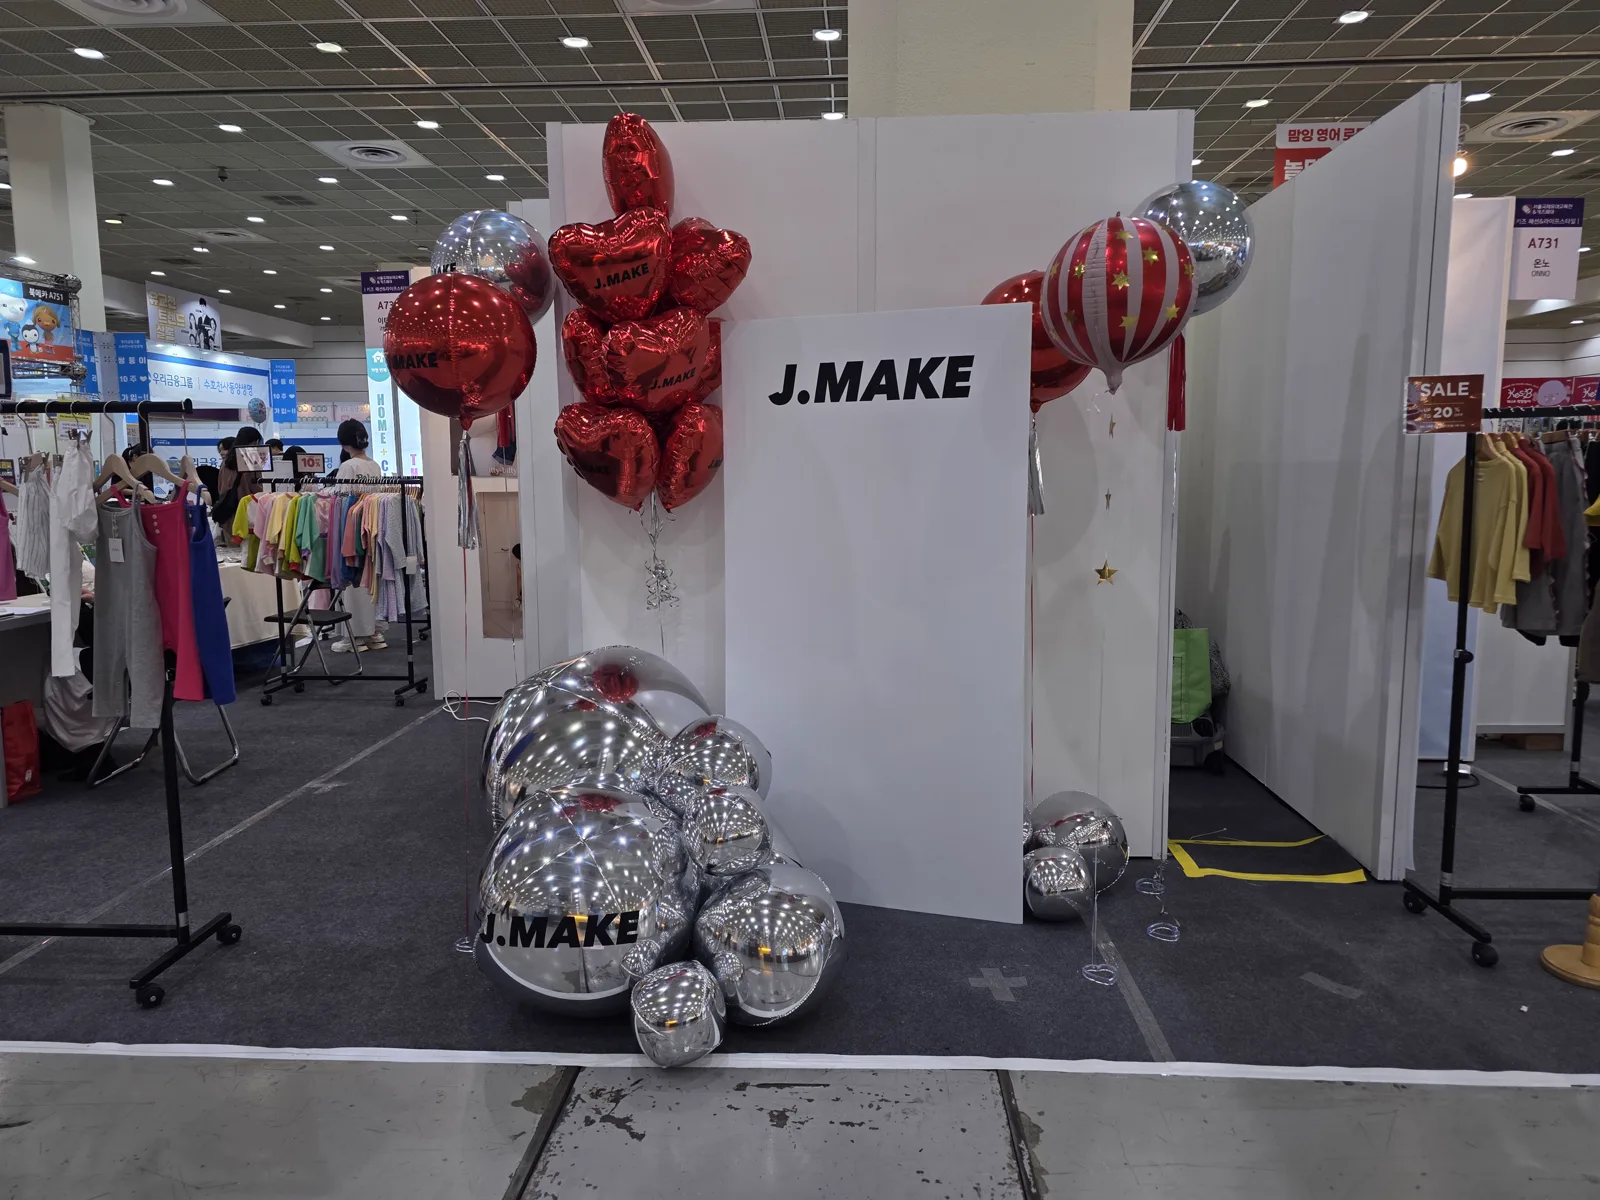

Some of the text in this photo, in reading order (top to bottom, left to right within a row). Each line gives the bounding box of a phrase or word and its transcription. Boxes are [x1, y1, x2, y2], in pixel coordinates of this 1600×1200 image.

[1316, 128, 1340, 142] 영어
[1528, 238, 1559, 249] A731
[1533, 258, 1550, 268] 온노
[594, 263, 650, 290] J.MAKE
[49, 291, 64, 301] A751
[159, 309, 185, 328] 트렌드
[152, 372, 254, 397] 우리금융그룹 수호천사동양생명
[650, 368, 697, 391] J.MAKE
[767, 354, 976, 406] J.MAKE
[1420, 382, 1470, 397] SALE
[1433, 406, 1453, 418] 20
[479, 910, 641, 949] J.MAKE
